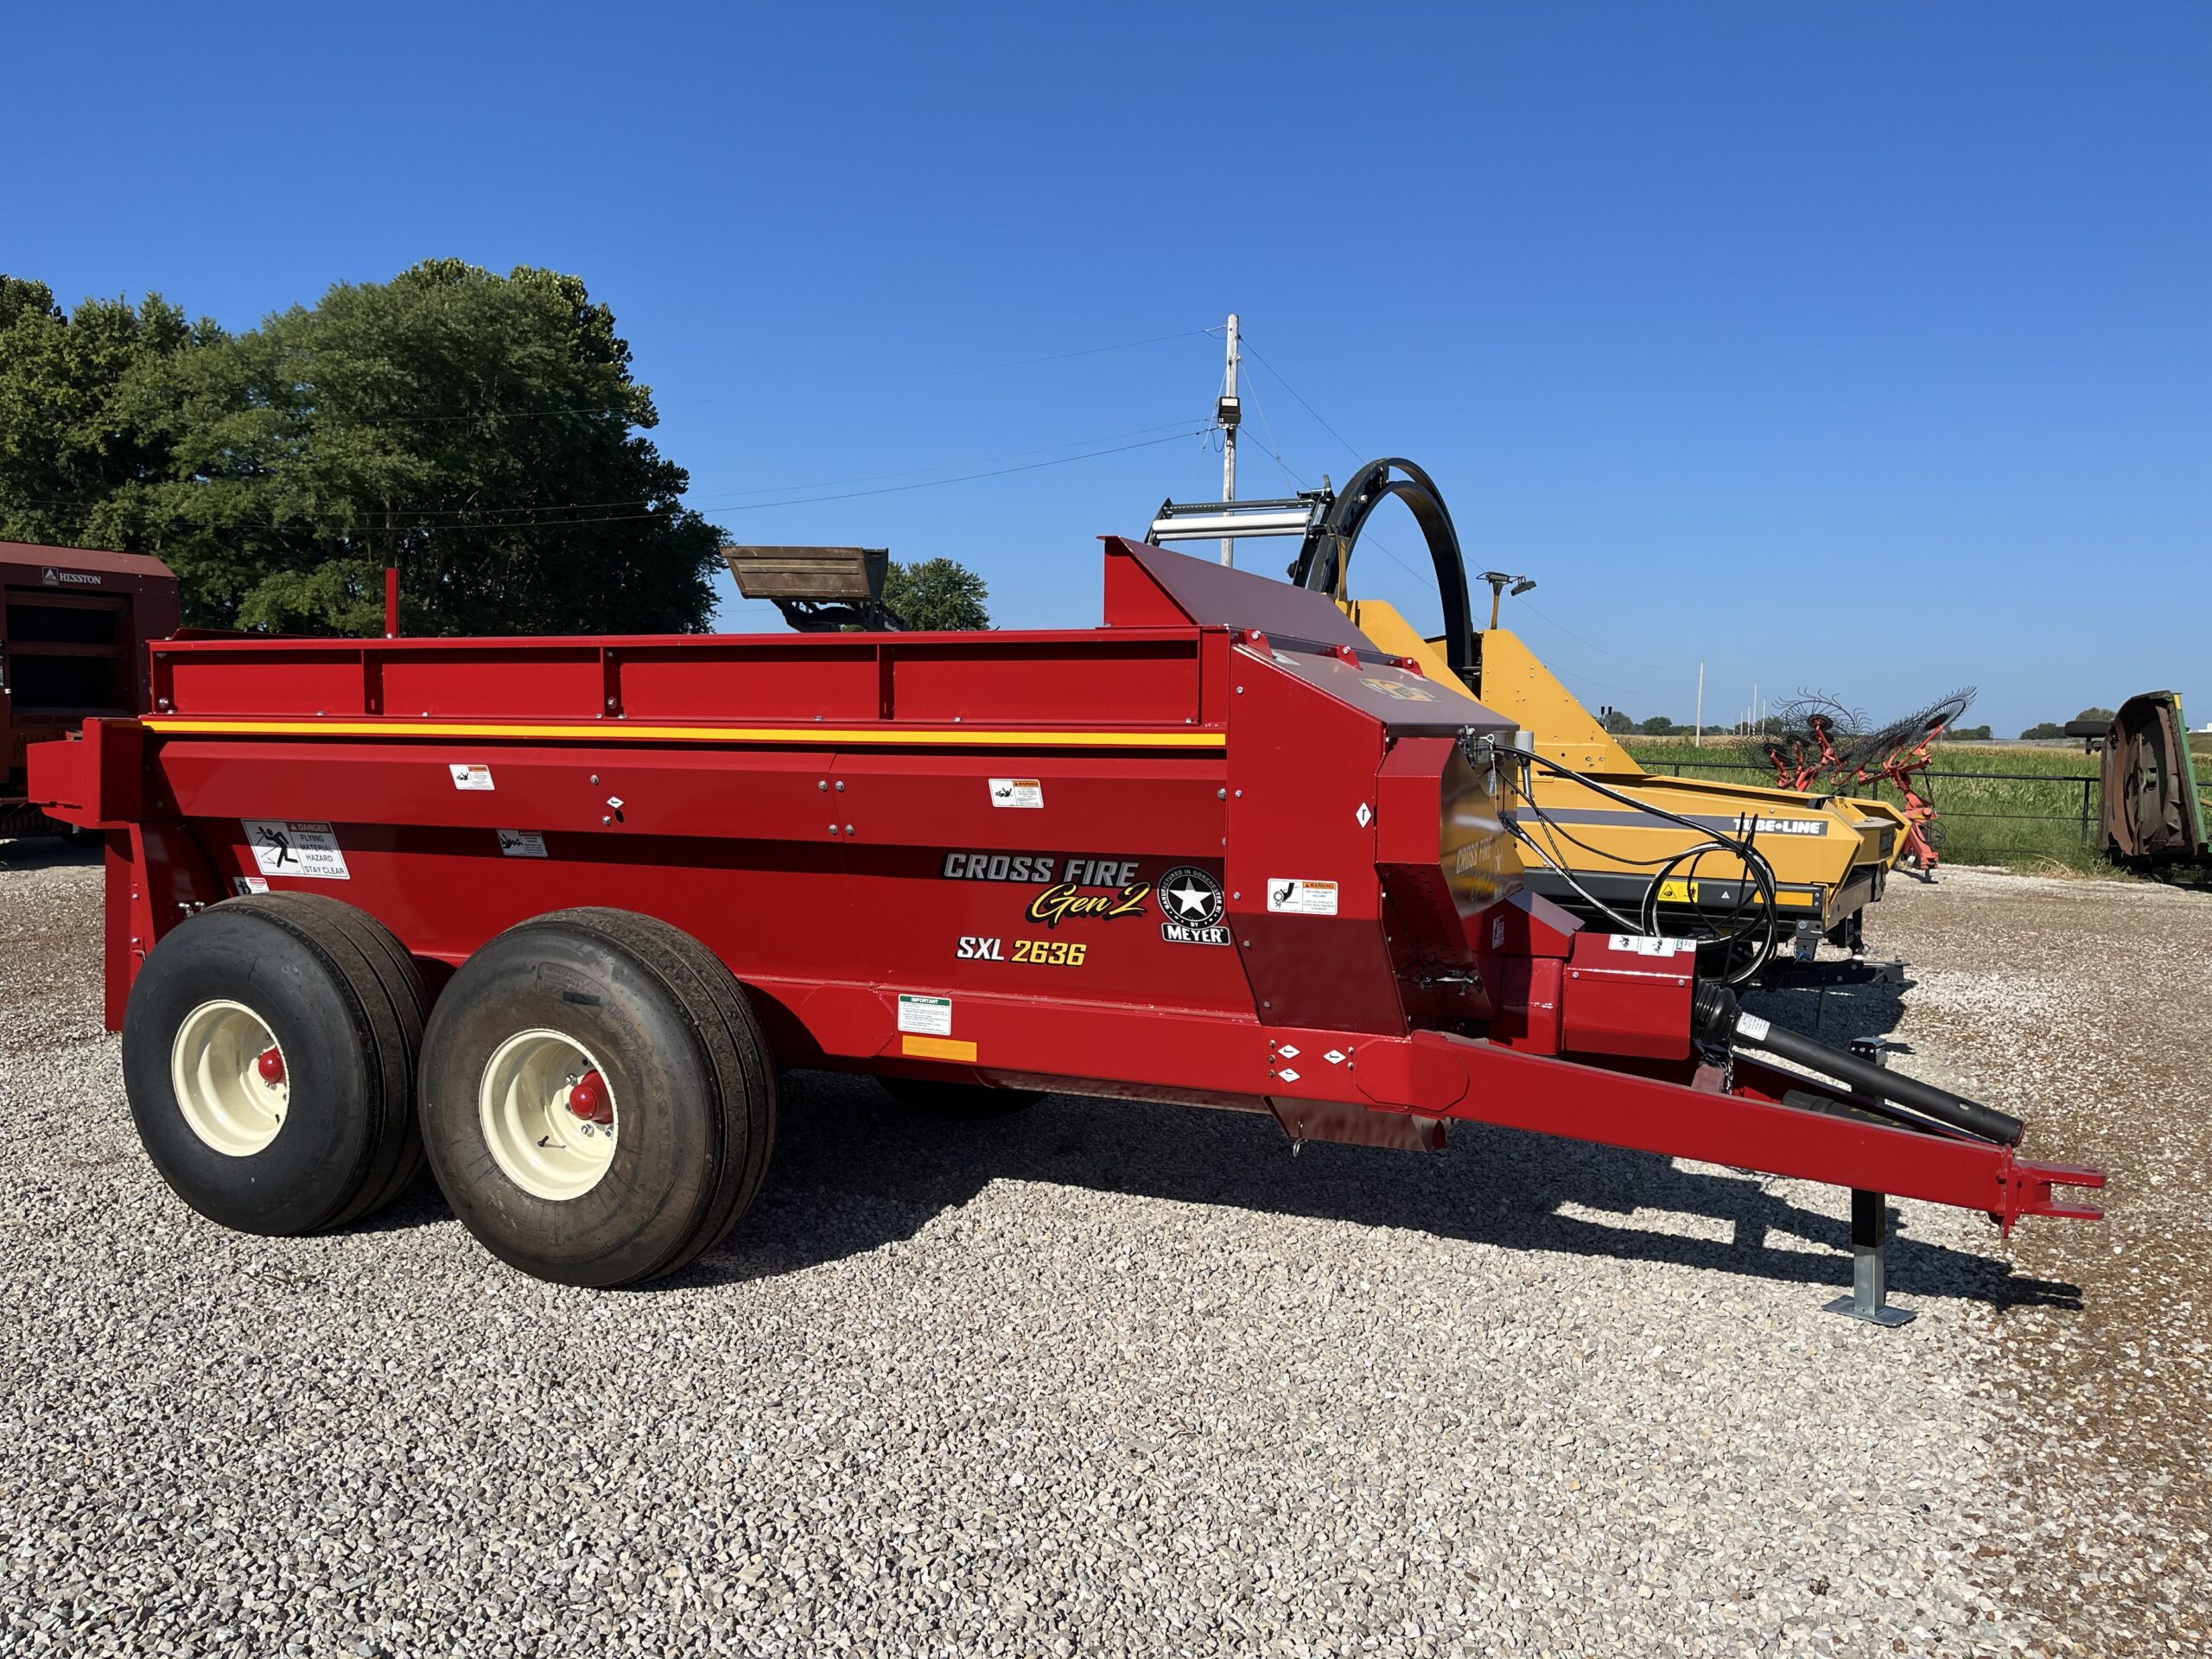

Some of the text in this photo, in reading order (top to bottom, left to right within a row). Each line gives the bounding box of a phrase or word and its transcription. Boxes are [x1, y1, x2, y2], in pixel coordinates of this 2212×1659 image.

[59, 572, 101, 585] HESSTON
[298, 823, 328, 832] DANGER
[944, 853, 1140, 887] CROSS FIRE
[1031, 881, 1151, 925] Gen 2
[1160, 869, 1183, 910] MANUFACTURED
[1166, 925, 1223, 944] MEYER
[957, 936, 1087, 966] SXL 2636
